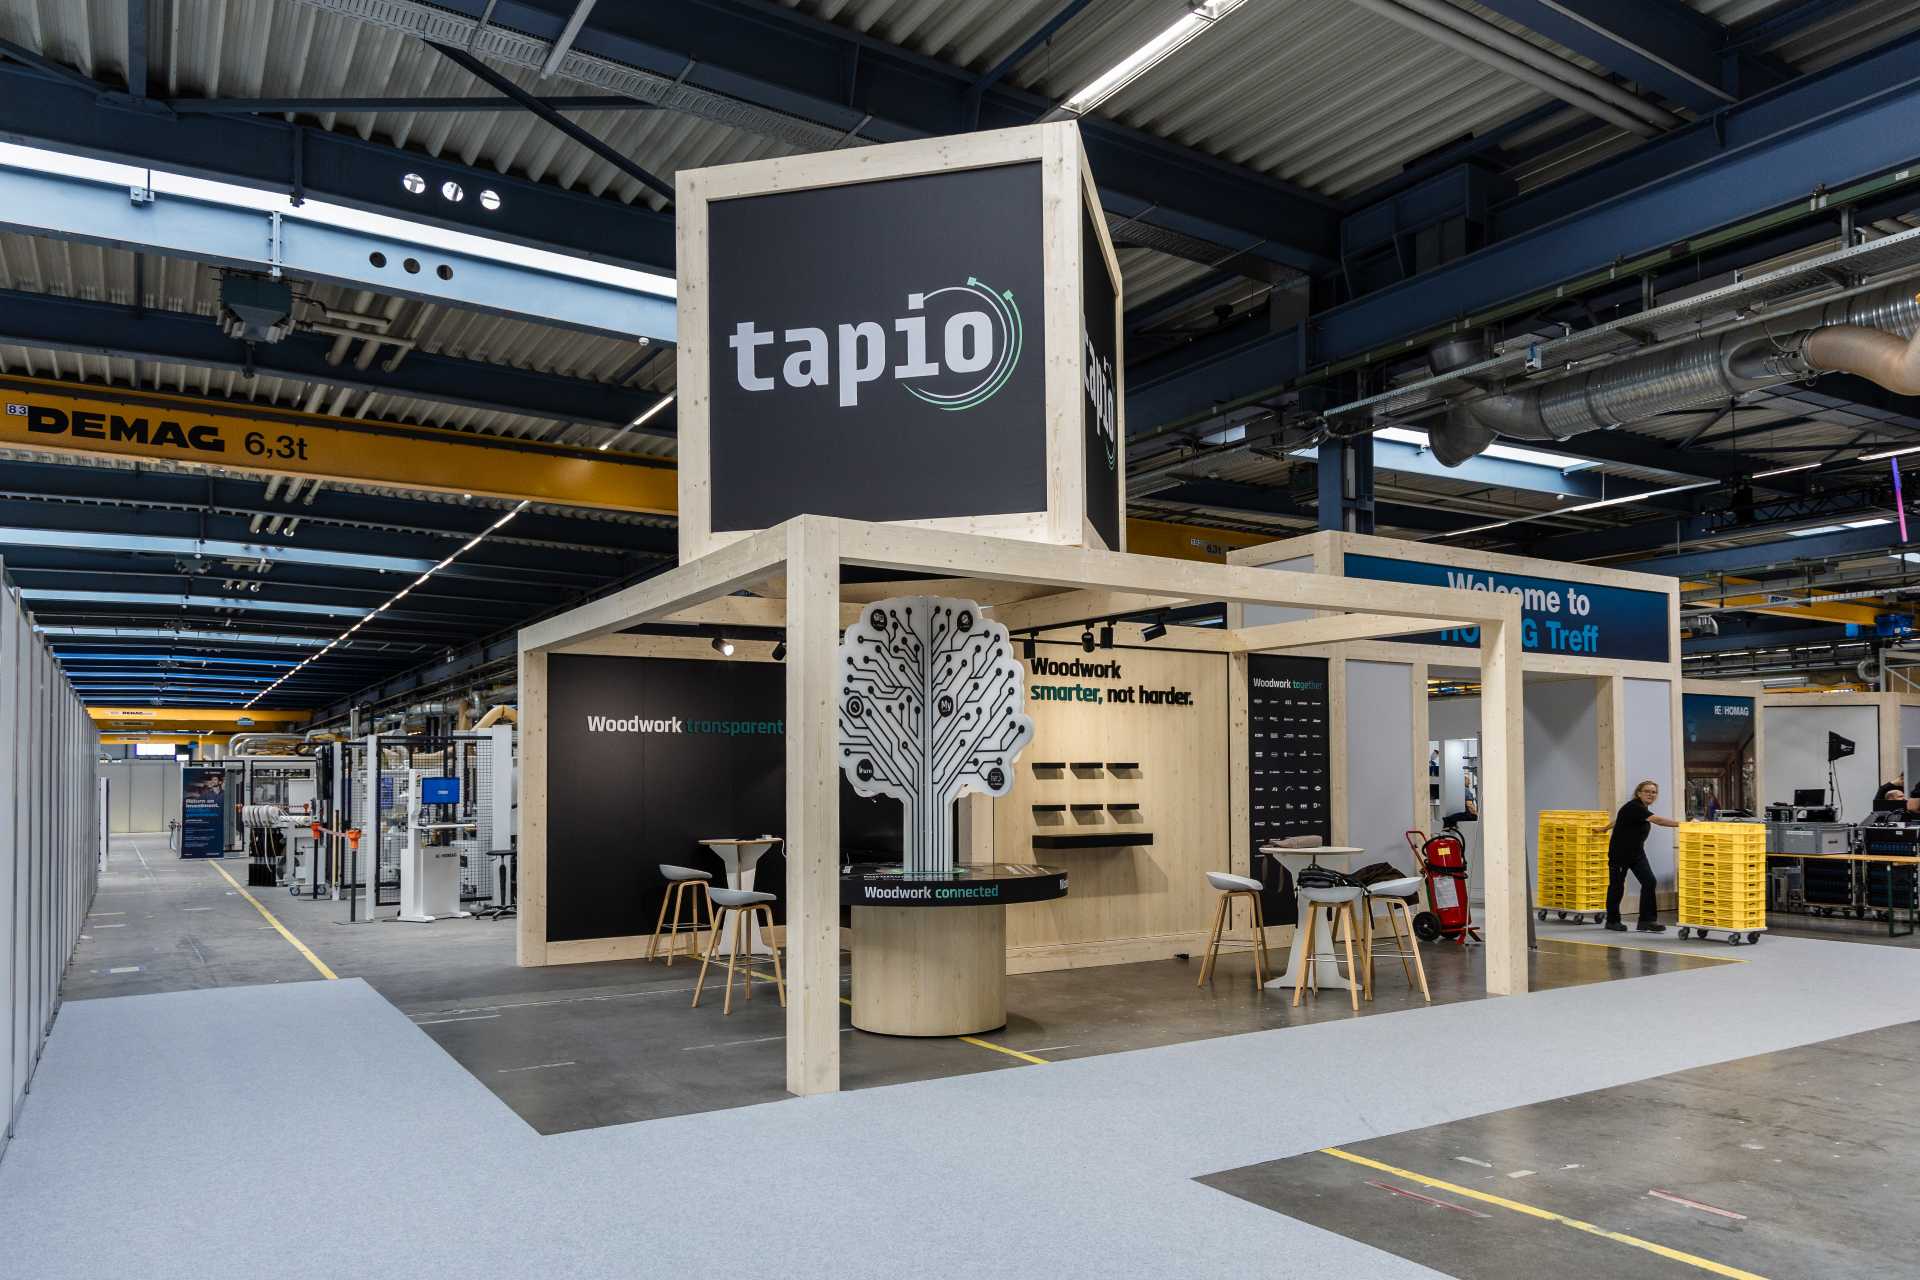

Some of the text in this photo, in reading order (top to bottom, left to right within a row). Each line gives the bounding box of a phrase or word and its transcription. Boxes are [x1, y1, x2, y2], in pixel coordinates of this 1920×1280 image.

[729, 292, 994, 408] tapio
[9, 405, 26, 415] 83
[27, 405, 309, 460] DEMAG 6,3t
[1567, 587, 1590, 616] to
[1545, 620, 1599, 653] Treff
[1031, 657, 1122, 679] Woodwork
[1253, 677, 1291, 689] Woodwork
[1031, 684, 1193, 706] smarter, not harder.
[1724, 705, 1749, 716] HOMAG
[587, 715, 784, 736] Woodwork transparent
[864, 884, 999, 899] Woodwork connected
